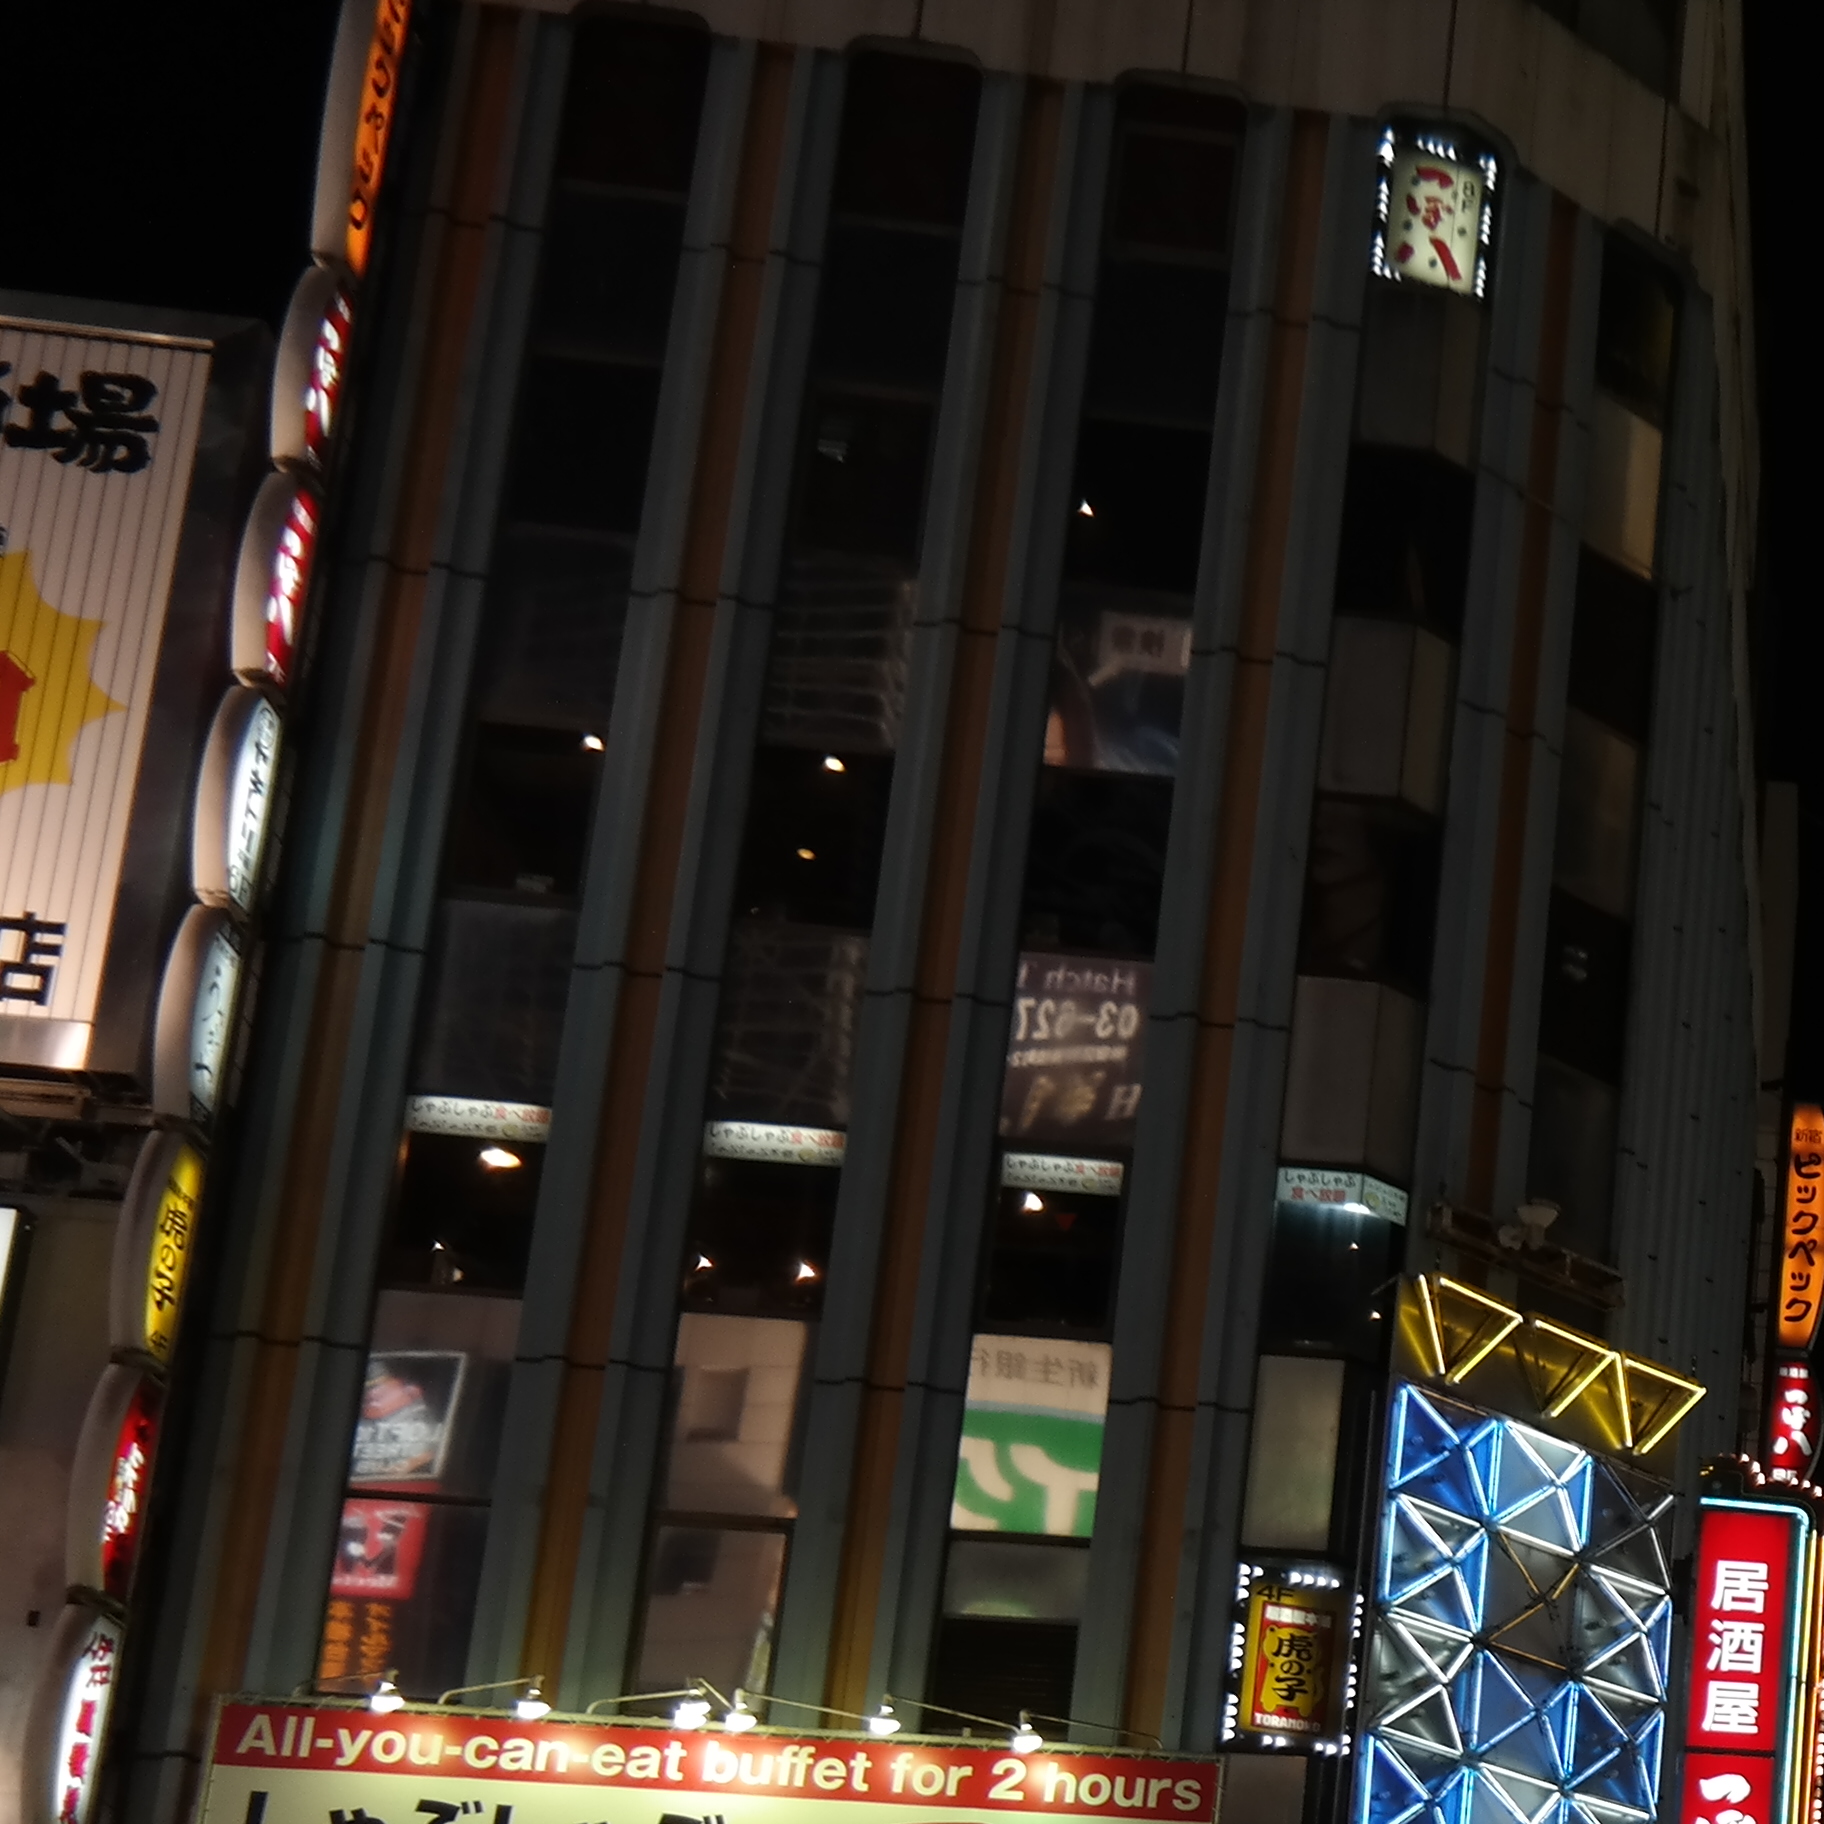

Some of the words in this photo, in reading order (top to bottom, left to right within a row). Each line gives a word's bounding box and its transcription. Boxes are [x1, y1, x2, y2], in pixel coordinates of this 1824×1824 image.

[1784, 1153, 1822, 1322] ビックペック
[1257, 1585, 1295, 1601] 4F
[1272, 1633, 1313, 1701] 虎の子
[1701, 1558, 1770, 1735] 居酒屋
[237, 1711, 686, 1783] All-you-can-eat
[702, 1741, 870, 1793] buffet
[890, 1753, 973, 1797] for
[989, 1758, 1027, 1800] 2
[1043, 1764, 1202, 1810] hours
